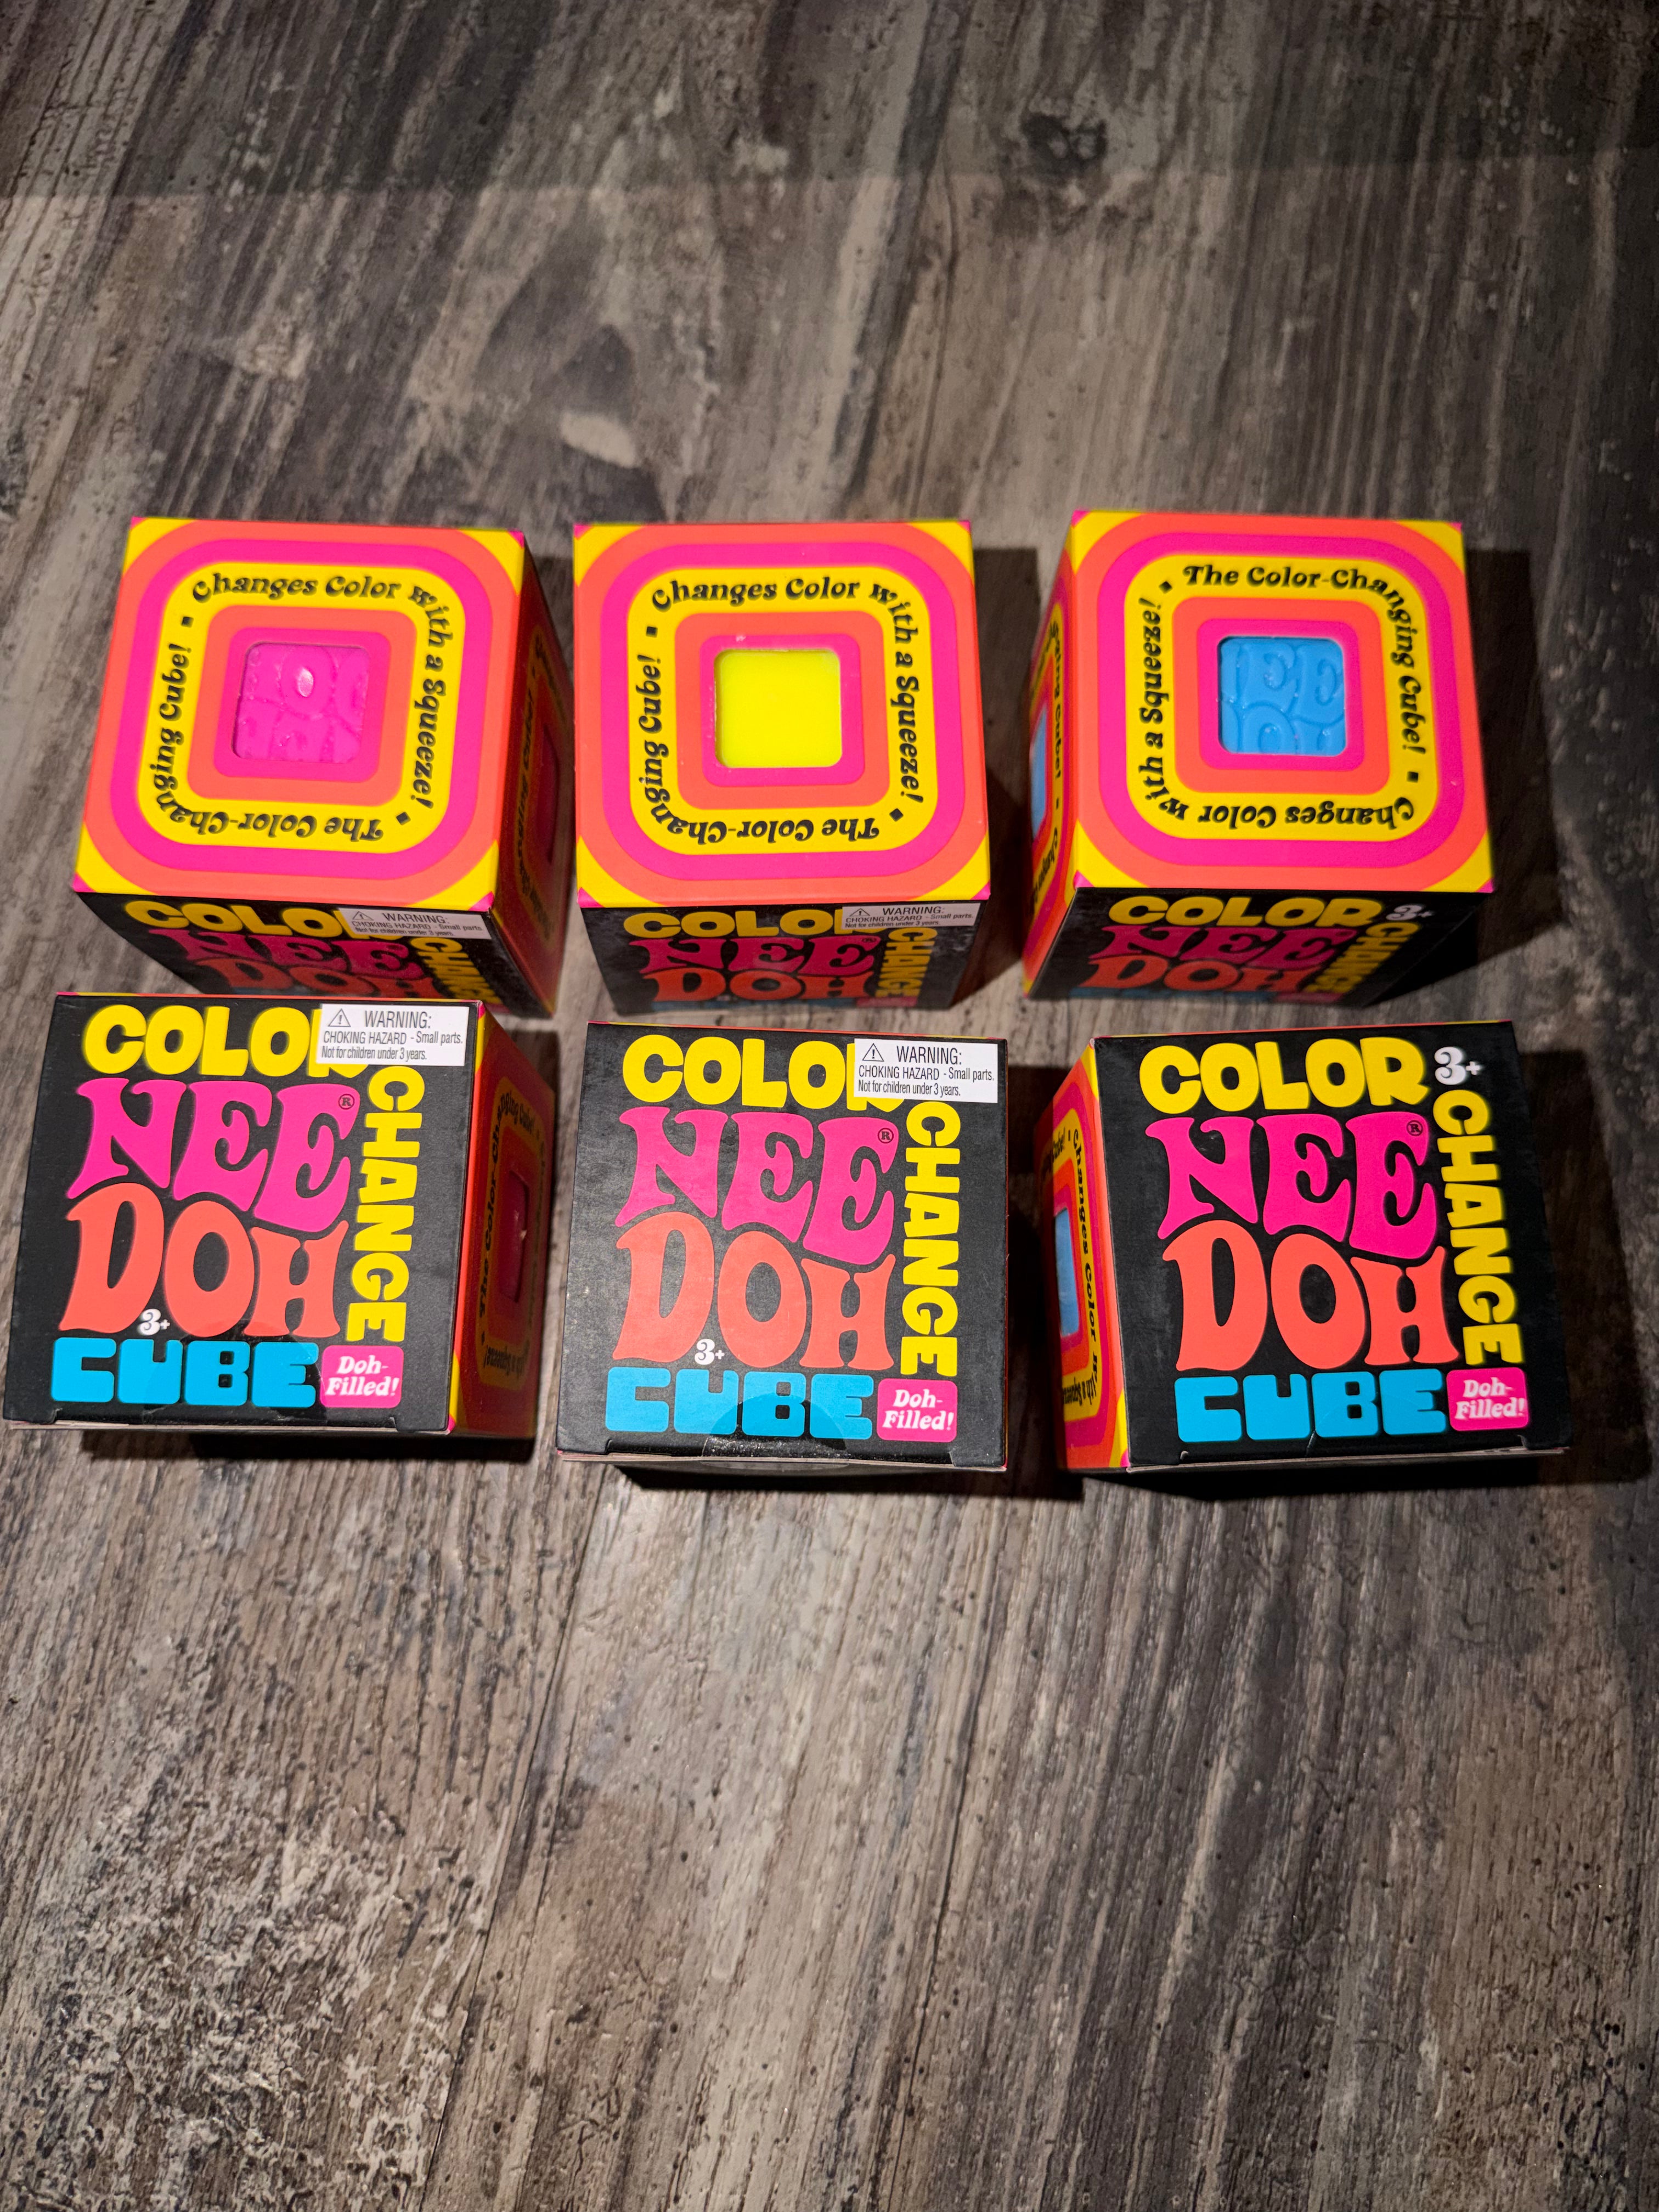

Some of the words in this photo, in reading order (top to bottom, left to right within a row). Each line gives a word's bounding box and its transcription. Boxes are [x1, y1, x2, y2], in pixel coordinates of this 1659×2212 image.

[193, 573, 316, 601] Changes
[326, 577, 399, 596] Color
[652, 580, 776, 610] Changes
[786, 577, 860, 597] Color
[871, 584, 918, 642] with
[426, 654, 442, 669] a
[896, 652, 912, 666] a
[1139, 598, 1169, 723] Squeeze!
[1184, 565, 1239, 584] The
[1248, 567, 1418, 680] Color-Changing
[1399, 675, 1426, 753] Cube!
[160, 644, 187, 720] Cube!
[636, 655, 661, 732] Cube!
[411, 679, 444, 807] Squeeze!
[891, 676, 923, 802] Squeeze!
[1146, 732, 1163, 748] a
[150, 728, 315, 840] Color-Changing
[639, 741, 814, 844] Color-Changing
[1139, 757, 1189, 820] with
[324, 817, 381, 840] The
[822, 818, 879, 841] The
[1198, 806, 1276, 829] Color
[1286, 797, 1414, 830] Changes
[125, 901, 404, 940] COLO
[382, 913, 450, 924] WARNING:
[623, 909, 887, 938] COLO
[883, 906, 944, 916] WARNING:
[1109, 896, 1384, 927] COLOR
[1386, 905, 1435, 921] 3+
[875, 927, 938, 997] CHANGE
[1079, 955, 1321, 993] DOH
[643, 968, 875, 1002] DOH
[364, 1010, 431, 1029] WARNING:
[84, 1005, 370, 1077] COLO
[321, 1046, 335, 1058] Not
[336, 1047, 346, 1058] for
[347, 1047, 375, 1059] children
[377, 1048, 398, 1059] under
[406, 1049, 427, 1062] years.
[324, 1031, 366, 1043] CHOKING
[369, 1032, 407, 1045] HAZARD
[416, 1031, 438, 1043] Small
[441, 1032, 462, 1046] parts.
[896, 1046, 962, 1064] WARNING:
[1434, 1046, 1482, 1086] 3+
[623, 1035, 905, 1113] COLO
[858, 1080, 871, 1092] Not
[872, 1080, 882, 1092] for
[883, 1081, 910, 1093] children
[913, 1083, 932, 1095] under
[940, 1085, 961, 1098] years.
[859, 1065, 899, 1079] CHOKING
[903, 1068, 939, 1080] HAZARD
[949, 1068, 970, 1080] Small
[973, 1070, 994, 1082] parts.
[1139, 1036, 1430, 1114] COLOR
[346, 1066, 426, 1342] CHANGE
[900, 1101, 961, 1376] CHANGE
[1073, 1128, 1088, 1254] Changes
[1085, 1262, 1096, 1341] Color
[1432, 1090, 1525, 1367] CHANGE
[58, 1182, 349, 1338] DOH
[612, 1212, 896, 1370] DOH
[1161, 1219, 1460, 1372] DOH
[138, 1308, 171, 1336] 3+
[336, 1355, 388, 1374] Doh-
[695, 1338, 725, 1365] 3+
[51, 1337, 319, 1408] CUBE
[325, 1376, 399, 1396] Filled!
[1462, 1376, 1513, 1401] Doh-
[605, 1366, 874, 1439] CUBE
[893, 1389, 943, 1408] Doh-
[1175, 1368, 1447, 1443] CUBE
[1455, 1397, 1525, 1420] Filled!
[882, 1407, 953, 1431] Filled!
